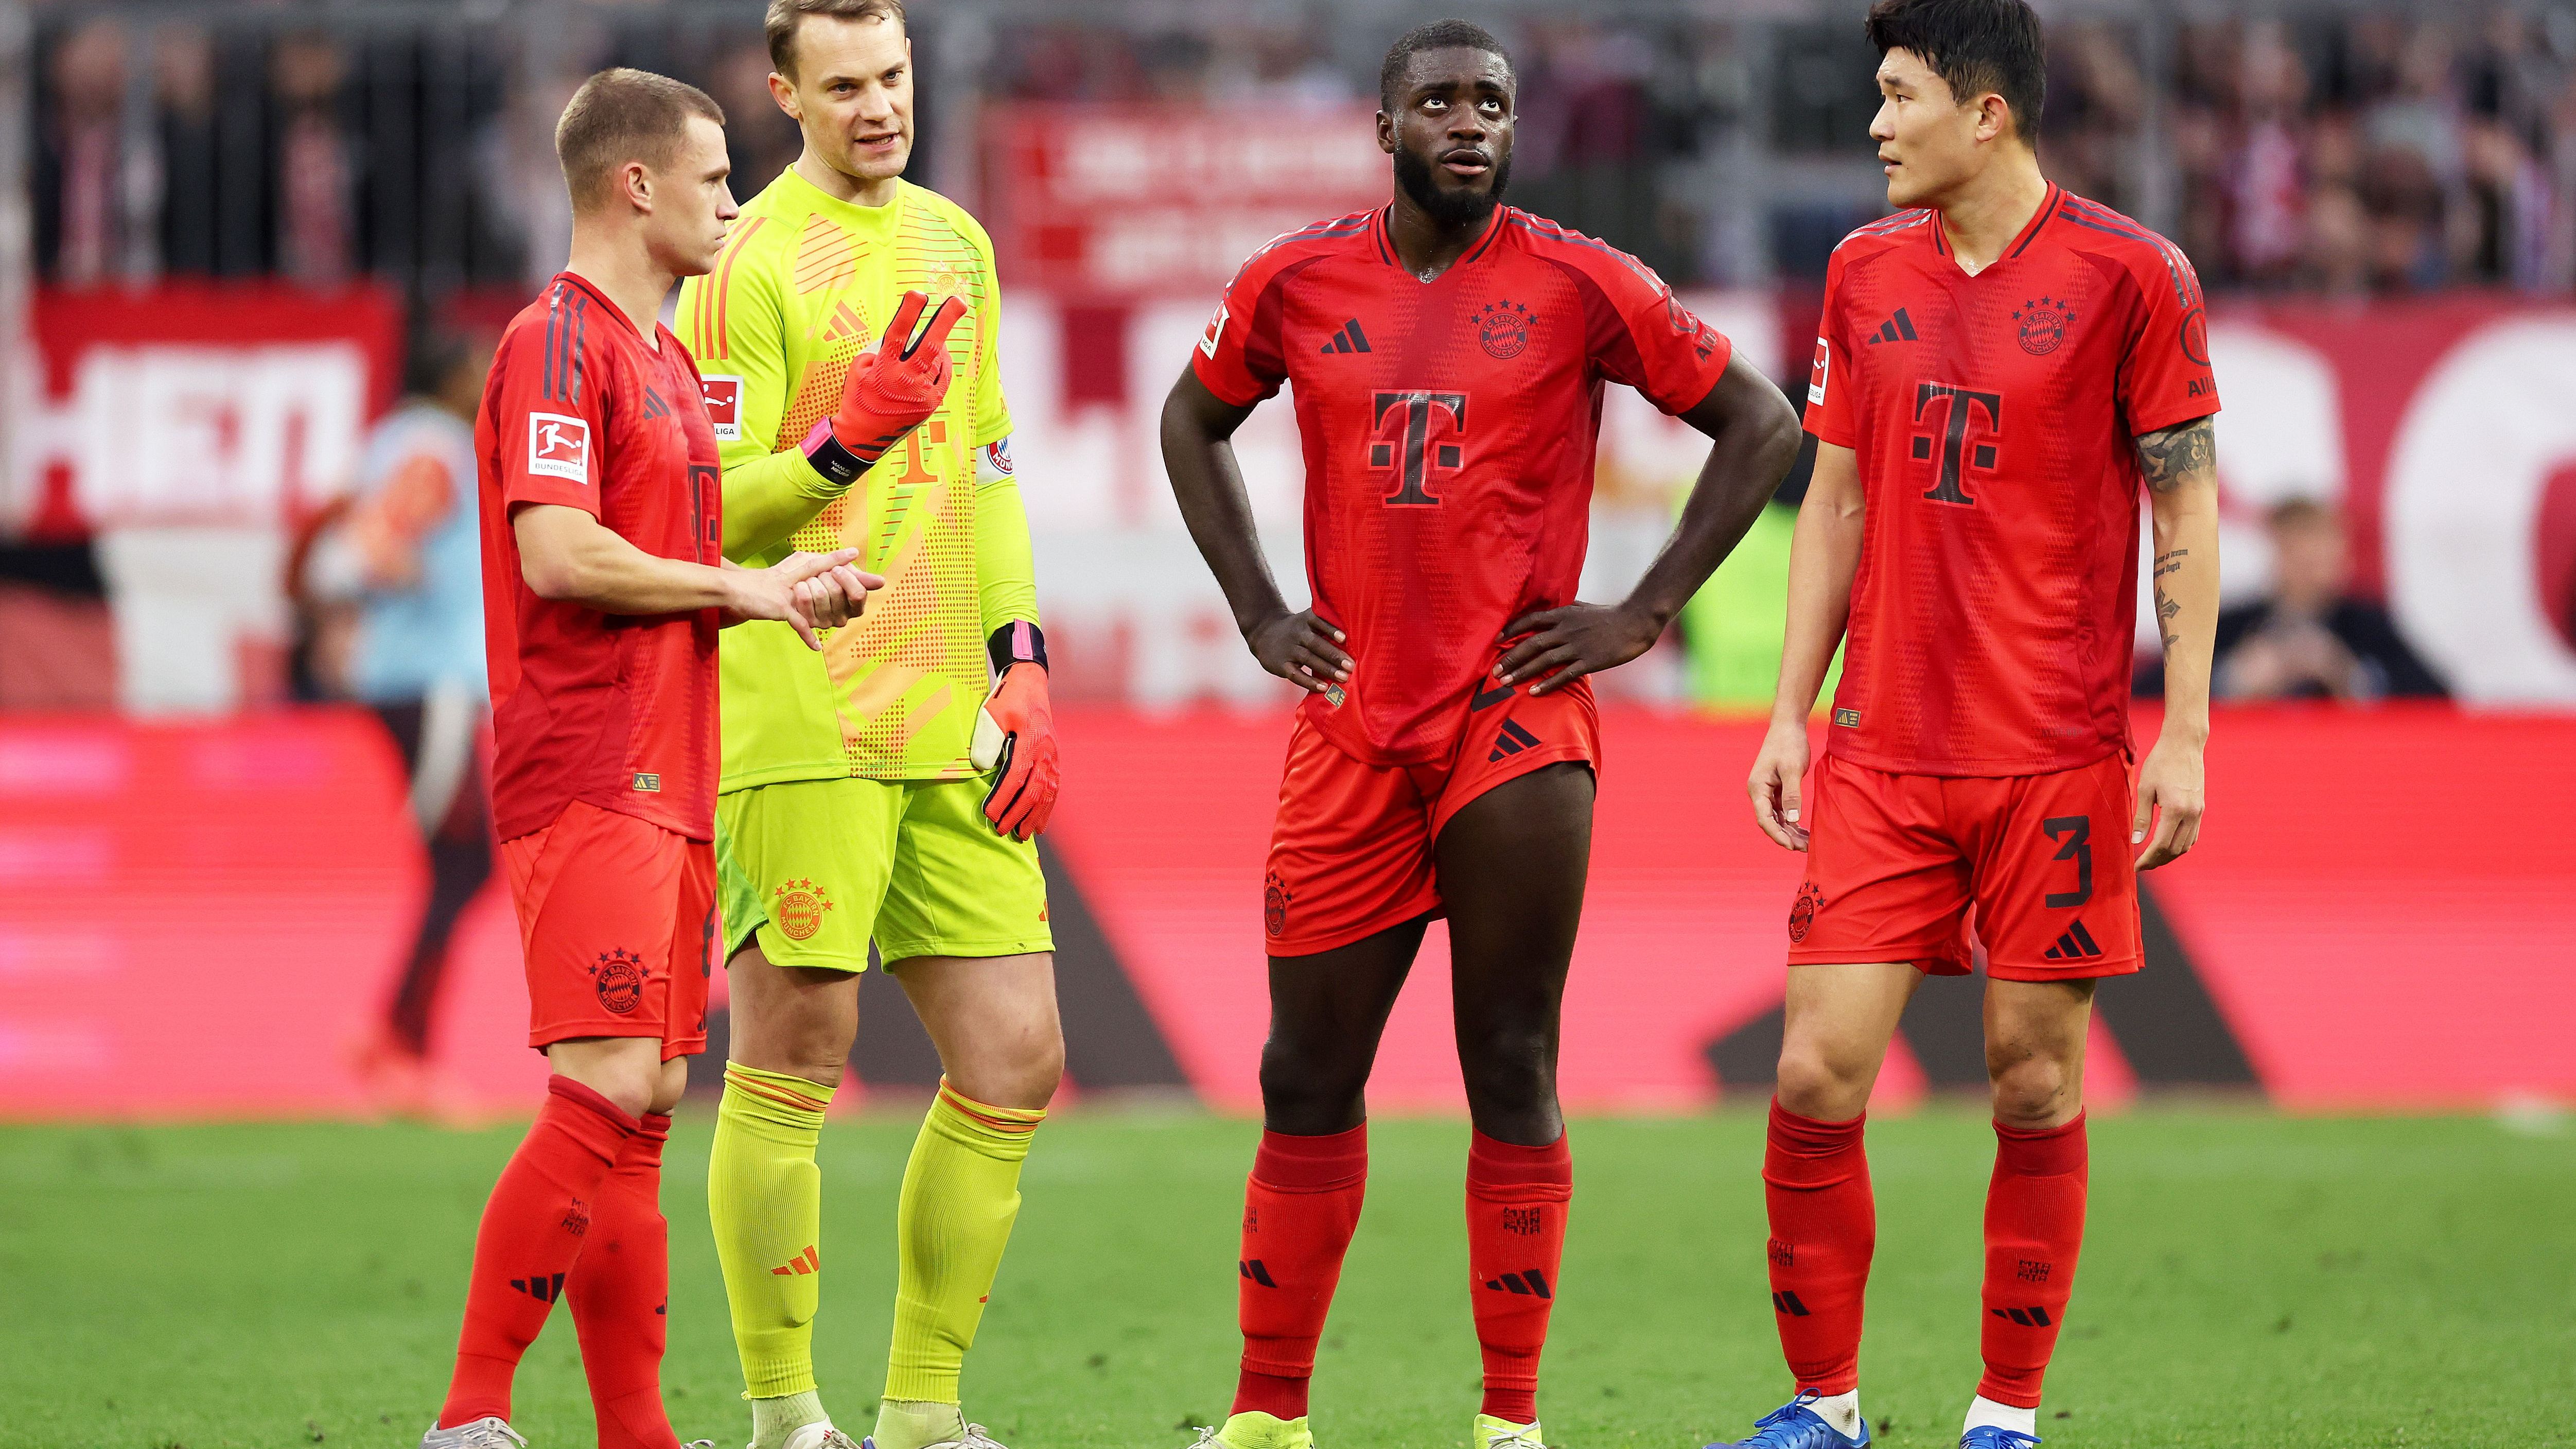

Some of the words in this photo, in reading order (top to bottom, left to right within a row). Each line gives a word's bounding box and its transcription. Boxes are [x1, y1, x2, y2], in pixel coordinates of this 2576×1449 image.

[1495, 316, 1523, 333] BAYERN
[535, 463, 583, 477] BUNDESLIGA
[2043, 815, 2093, 908] 3
[783, 898, 792, 909] FC
[793, 895, 819, 916] BAYERN
